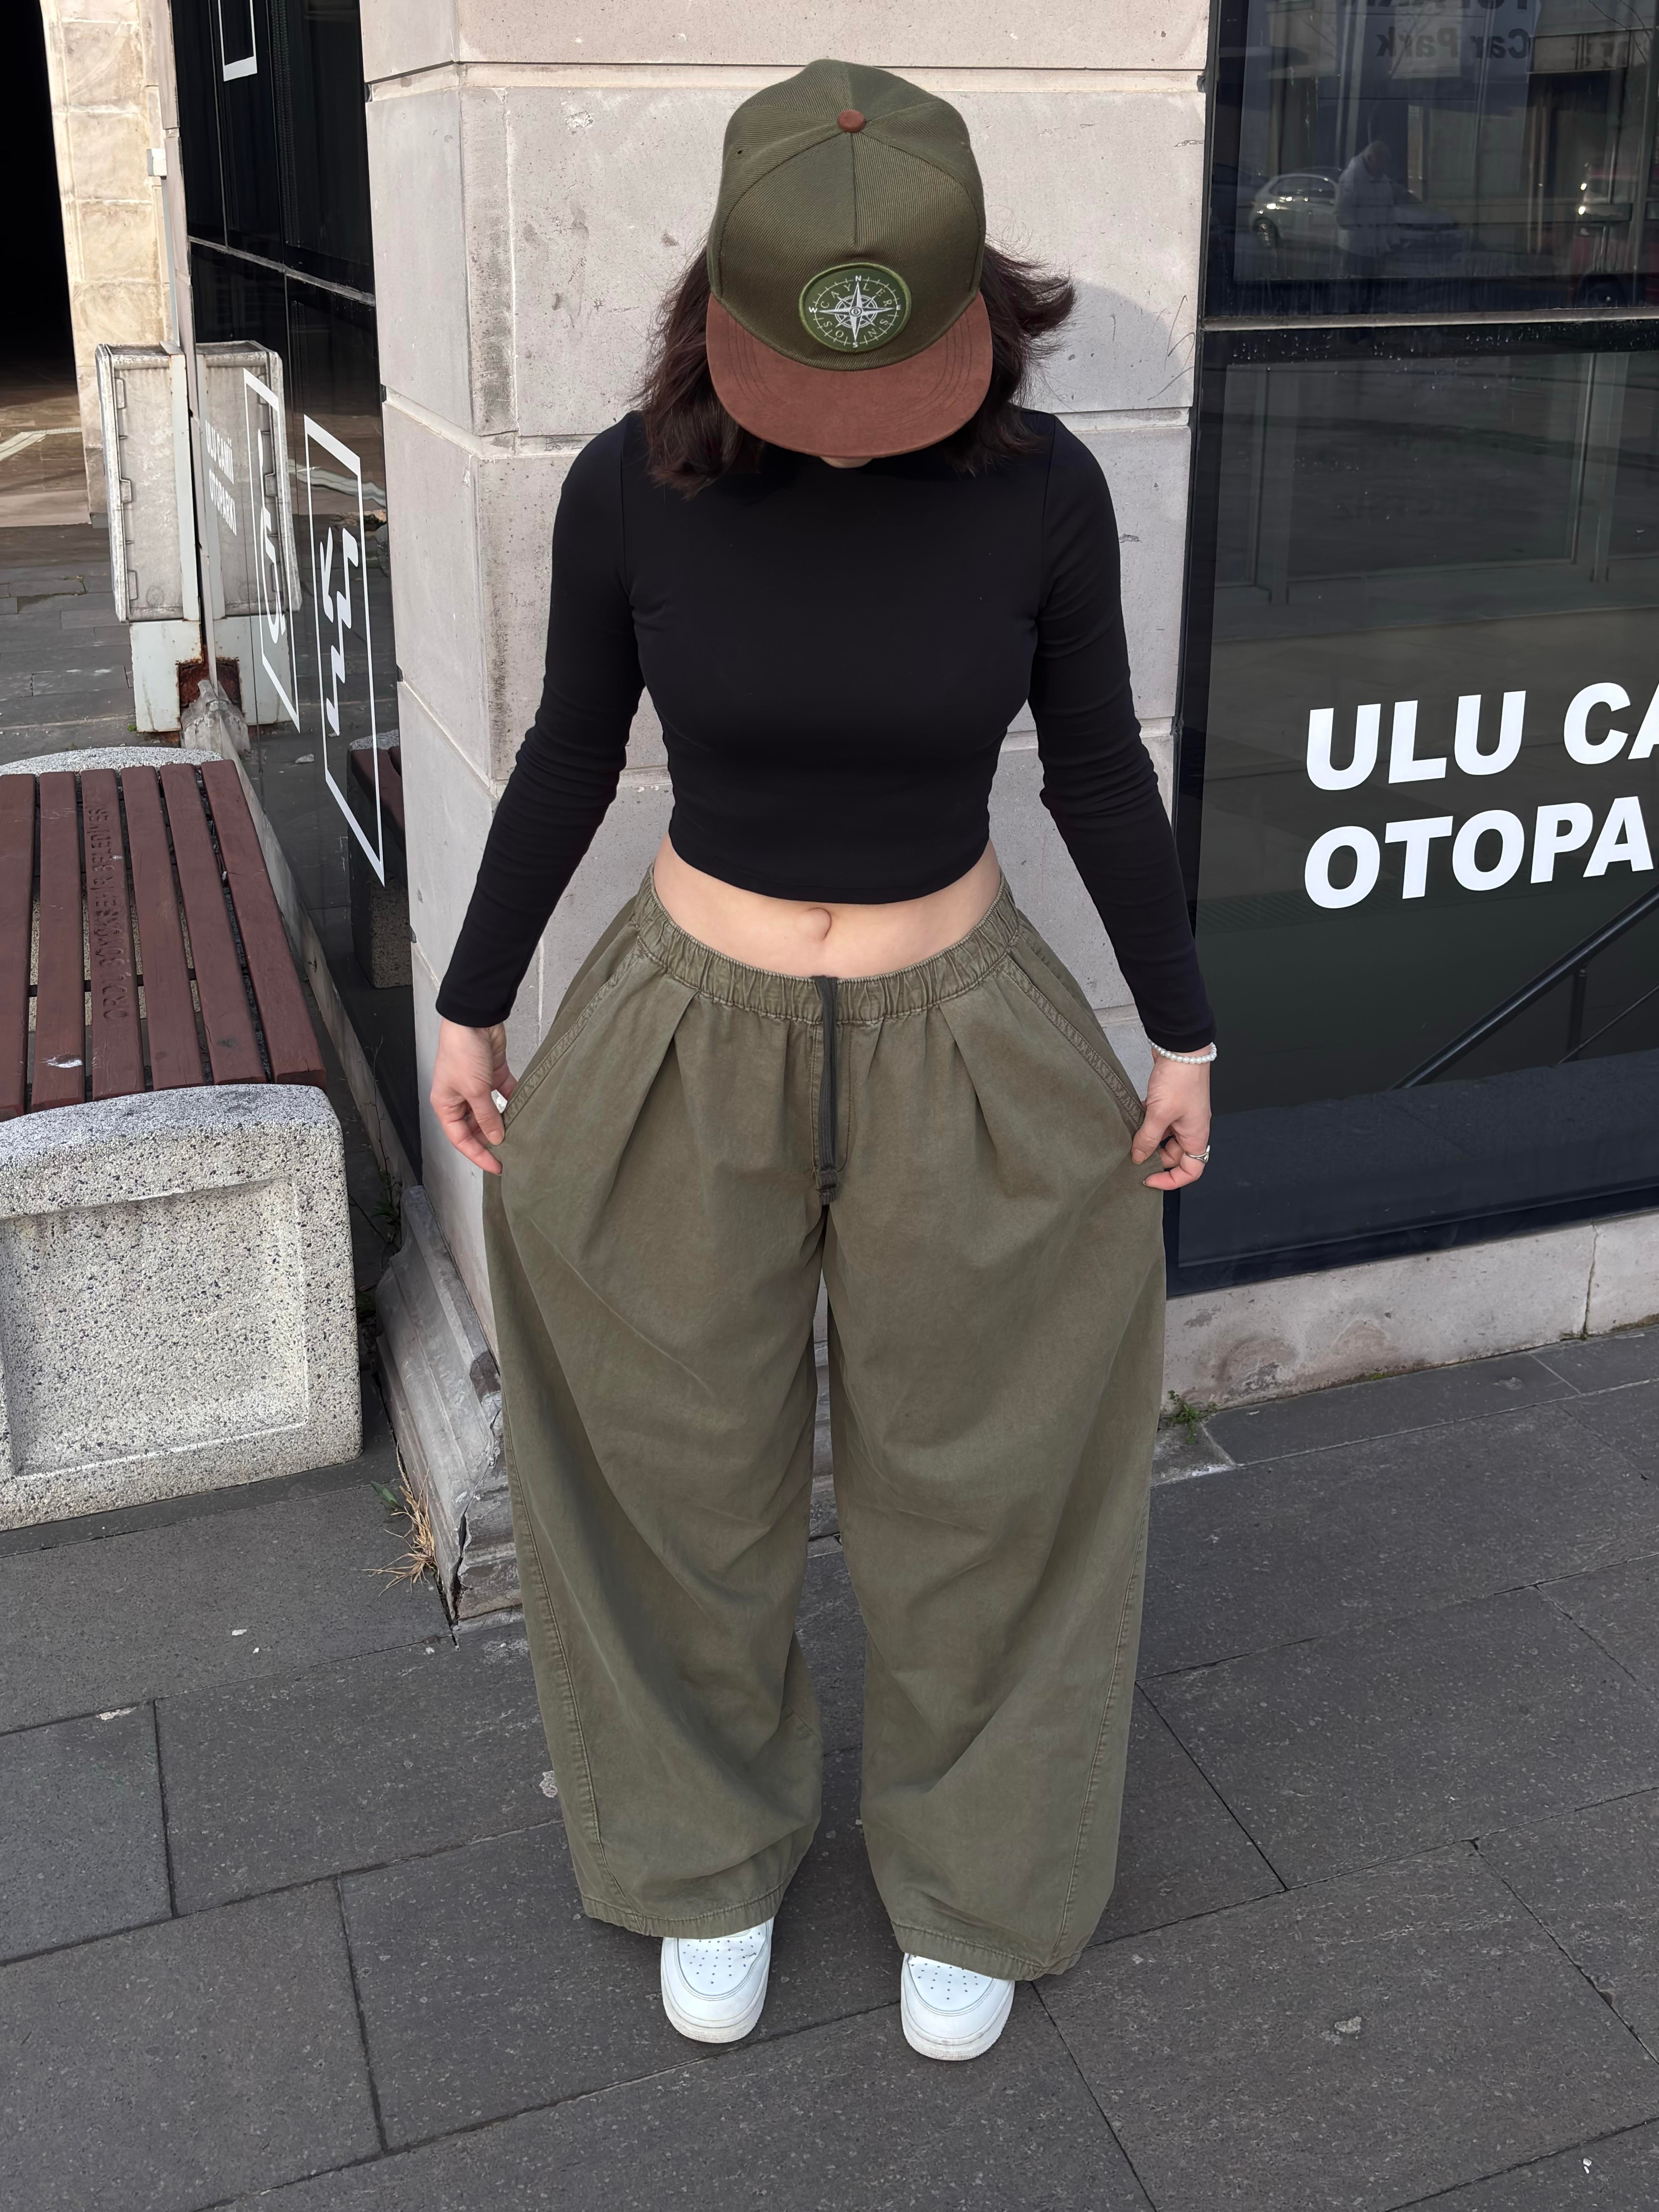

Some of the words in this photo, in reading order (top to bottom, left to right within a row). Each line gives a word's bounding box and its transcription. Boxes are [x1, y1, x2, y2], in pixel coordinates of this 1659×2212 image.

[820, 283, 892, 309] CAYLER
[1306, 691, 1526, 791] ULU
[1305, 796, 1654, 908] OTOPA
